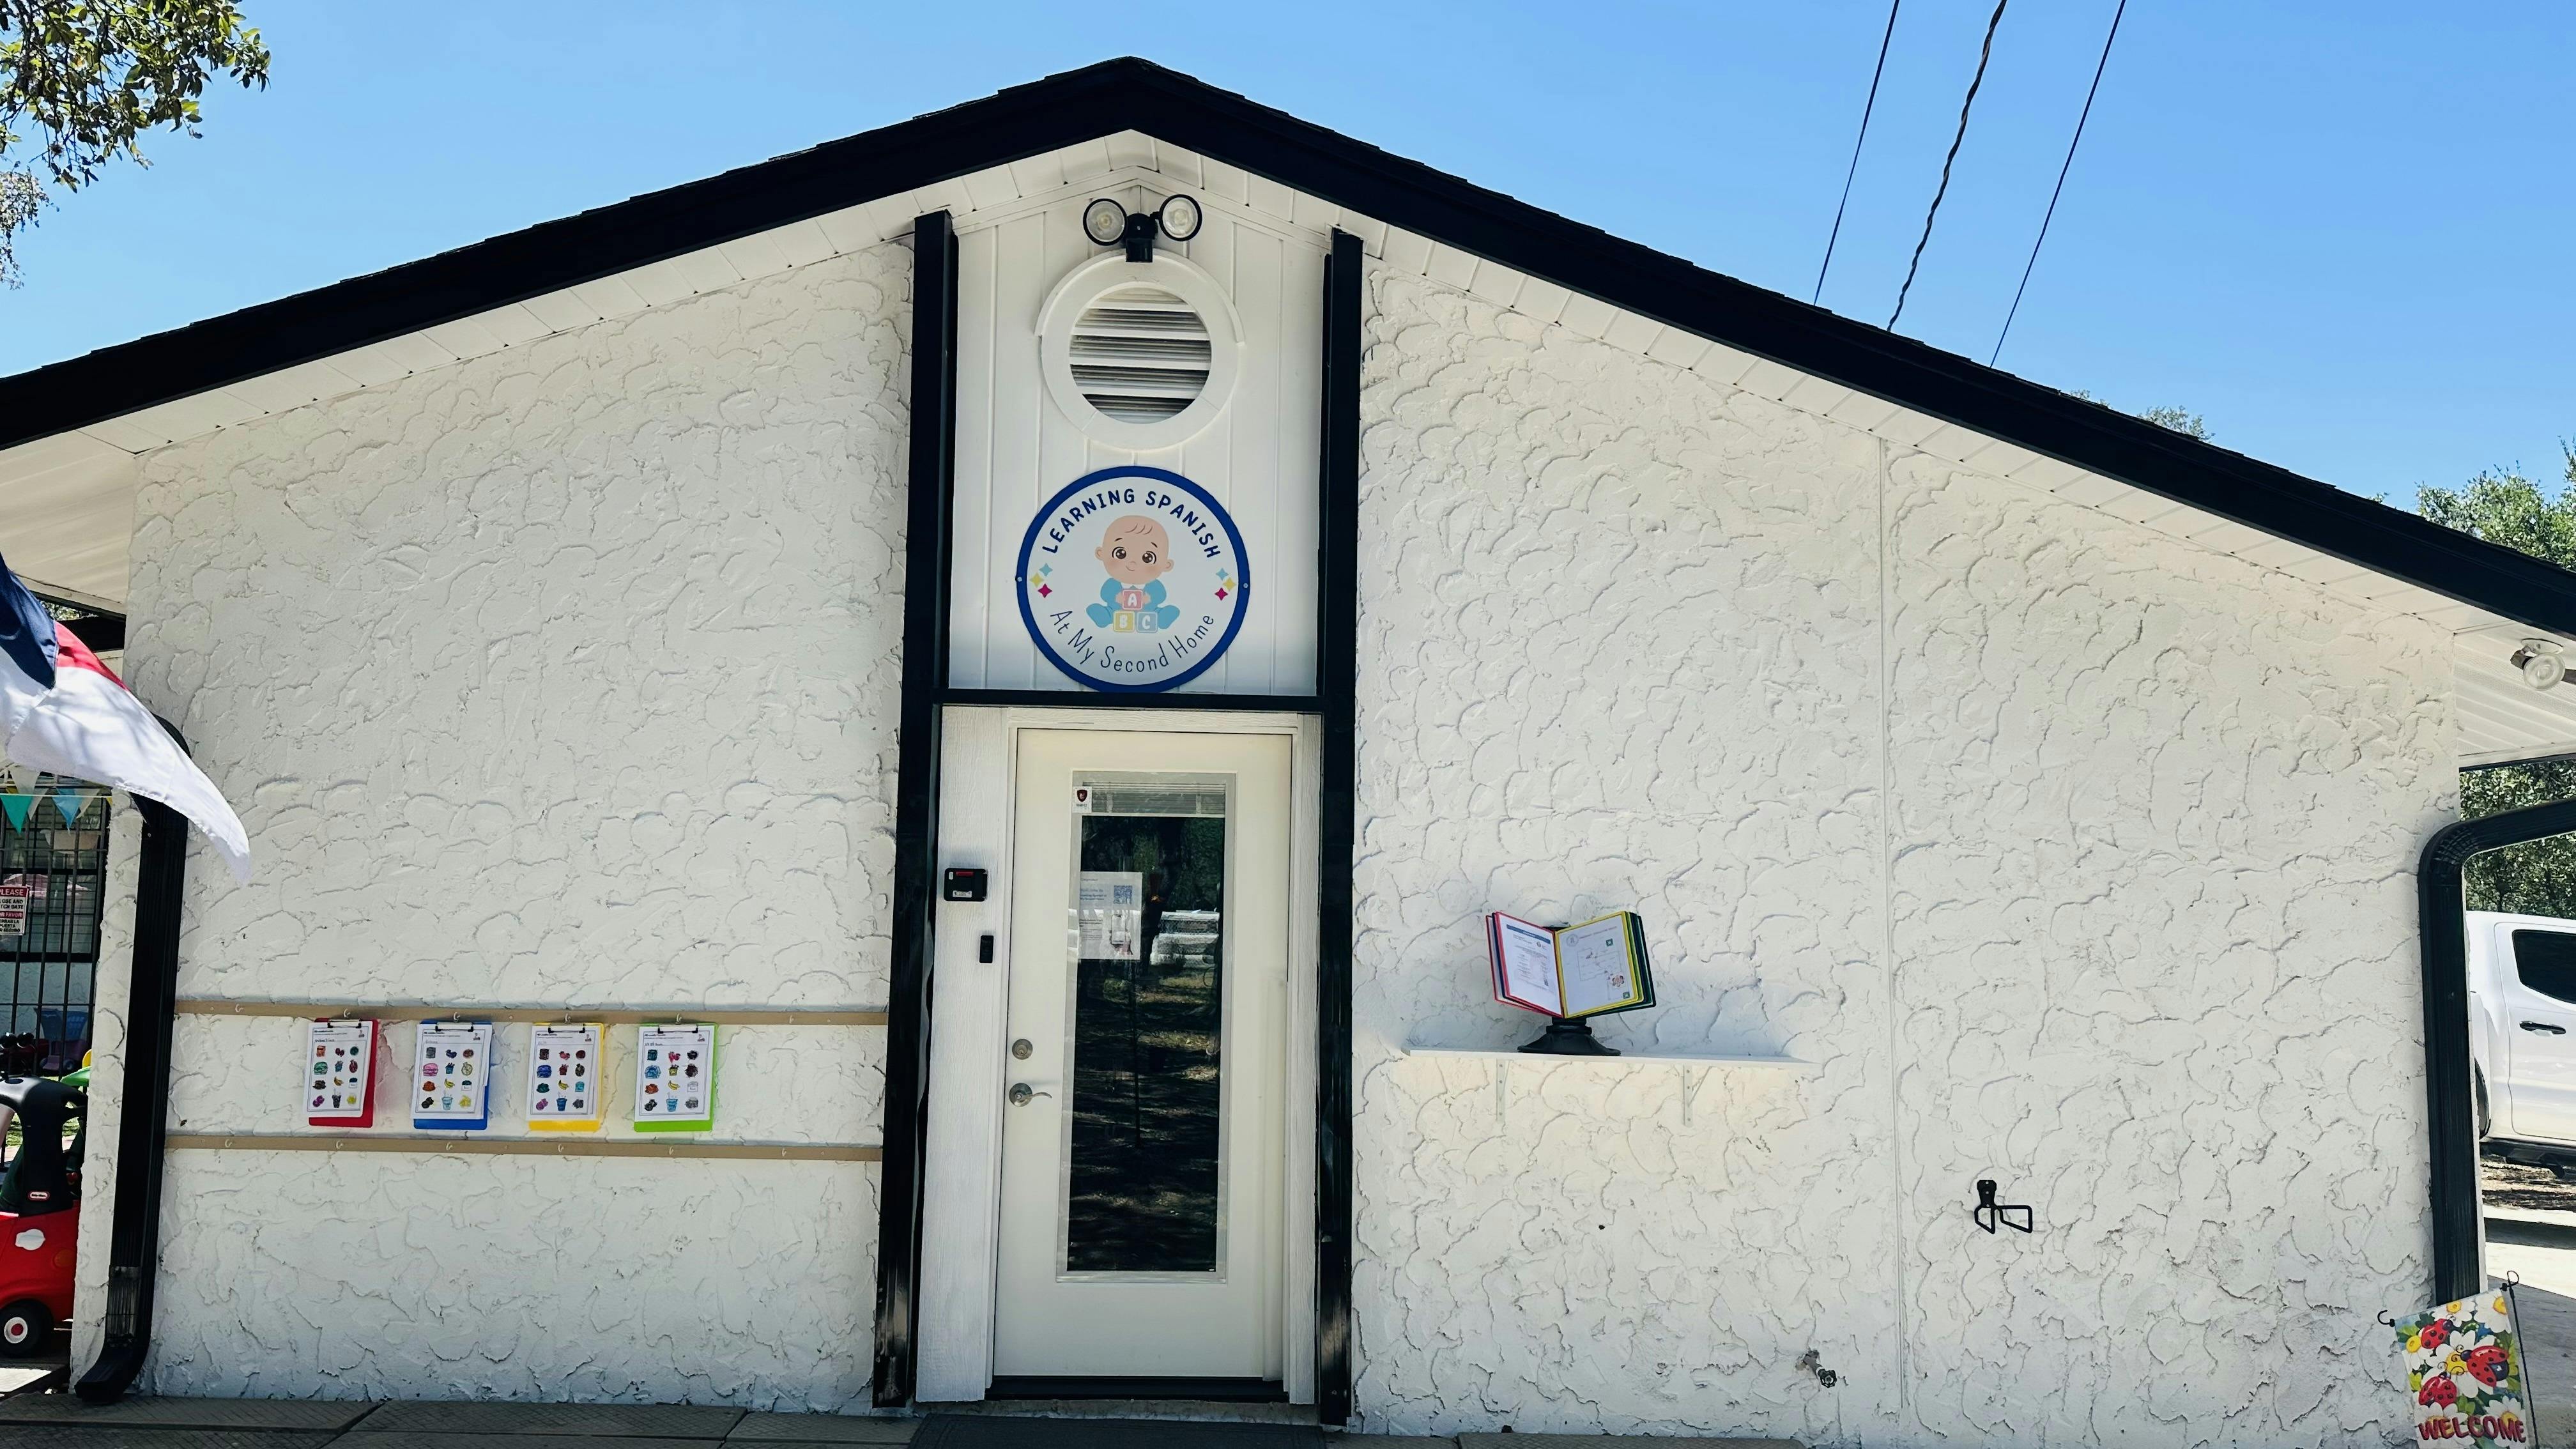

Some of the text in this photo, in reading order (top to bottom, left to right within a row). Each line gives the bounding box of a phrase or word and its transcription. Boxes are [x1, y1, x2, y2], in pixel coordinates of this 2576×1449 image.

[1042, 488, 1221, 558] LEARNING SPANISH
[1128, 593, 1138, 606] A
[1119, 614, 1151, 630] B C
[1050, 610, 1214, 673] At My Second Home
[2418, 1415, 2527, 1443] WELCOME
